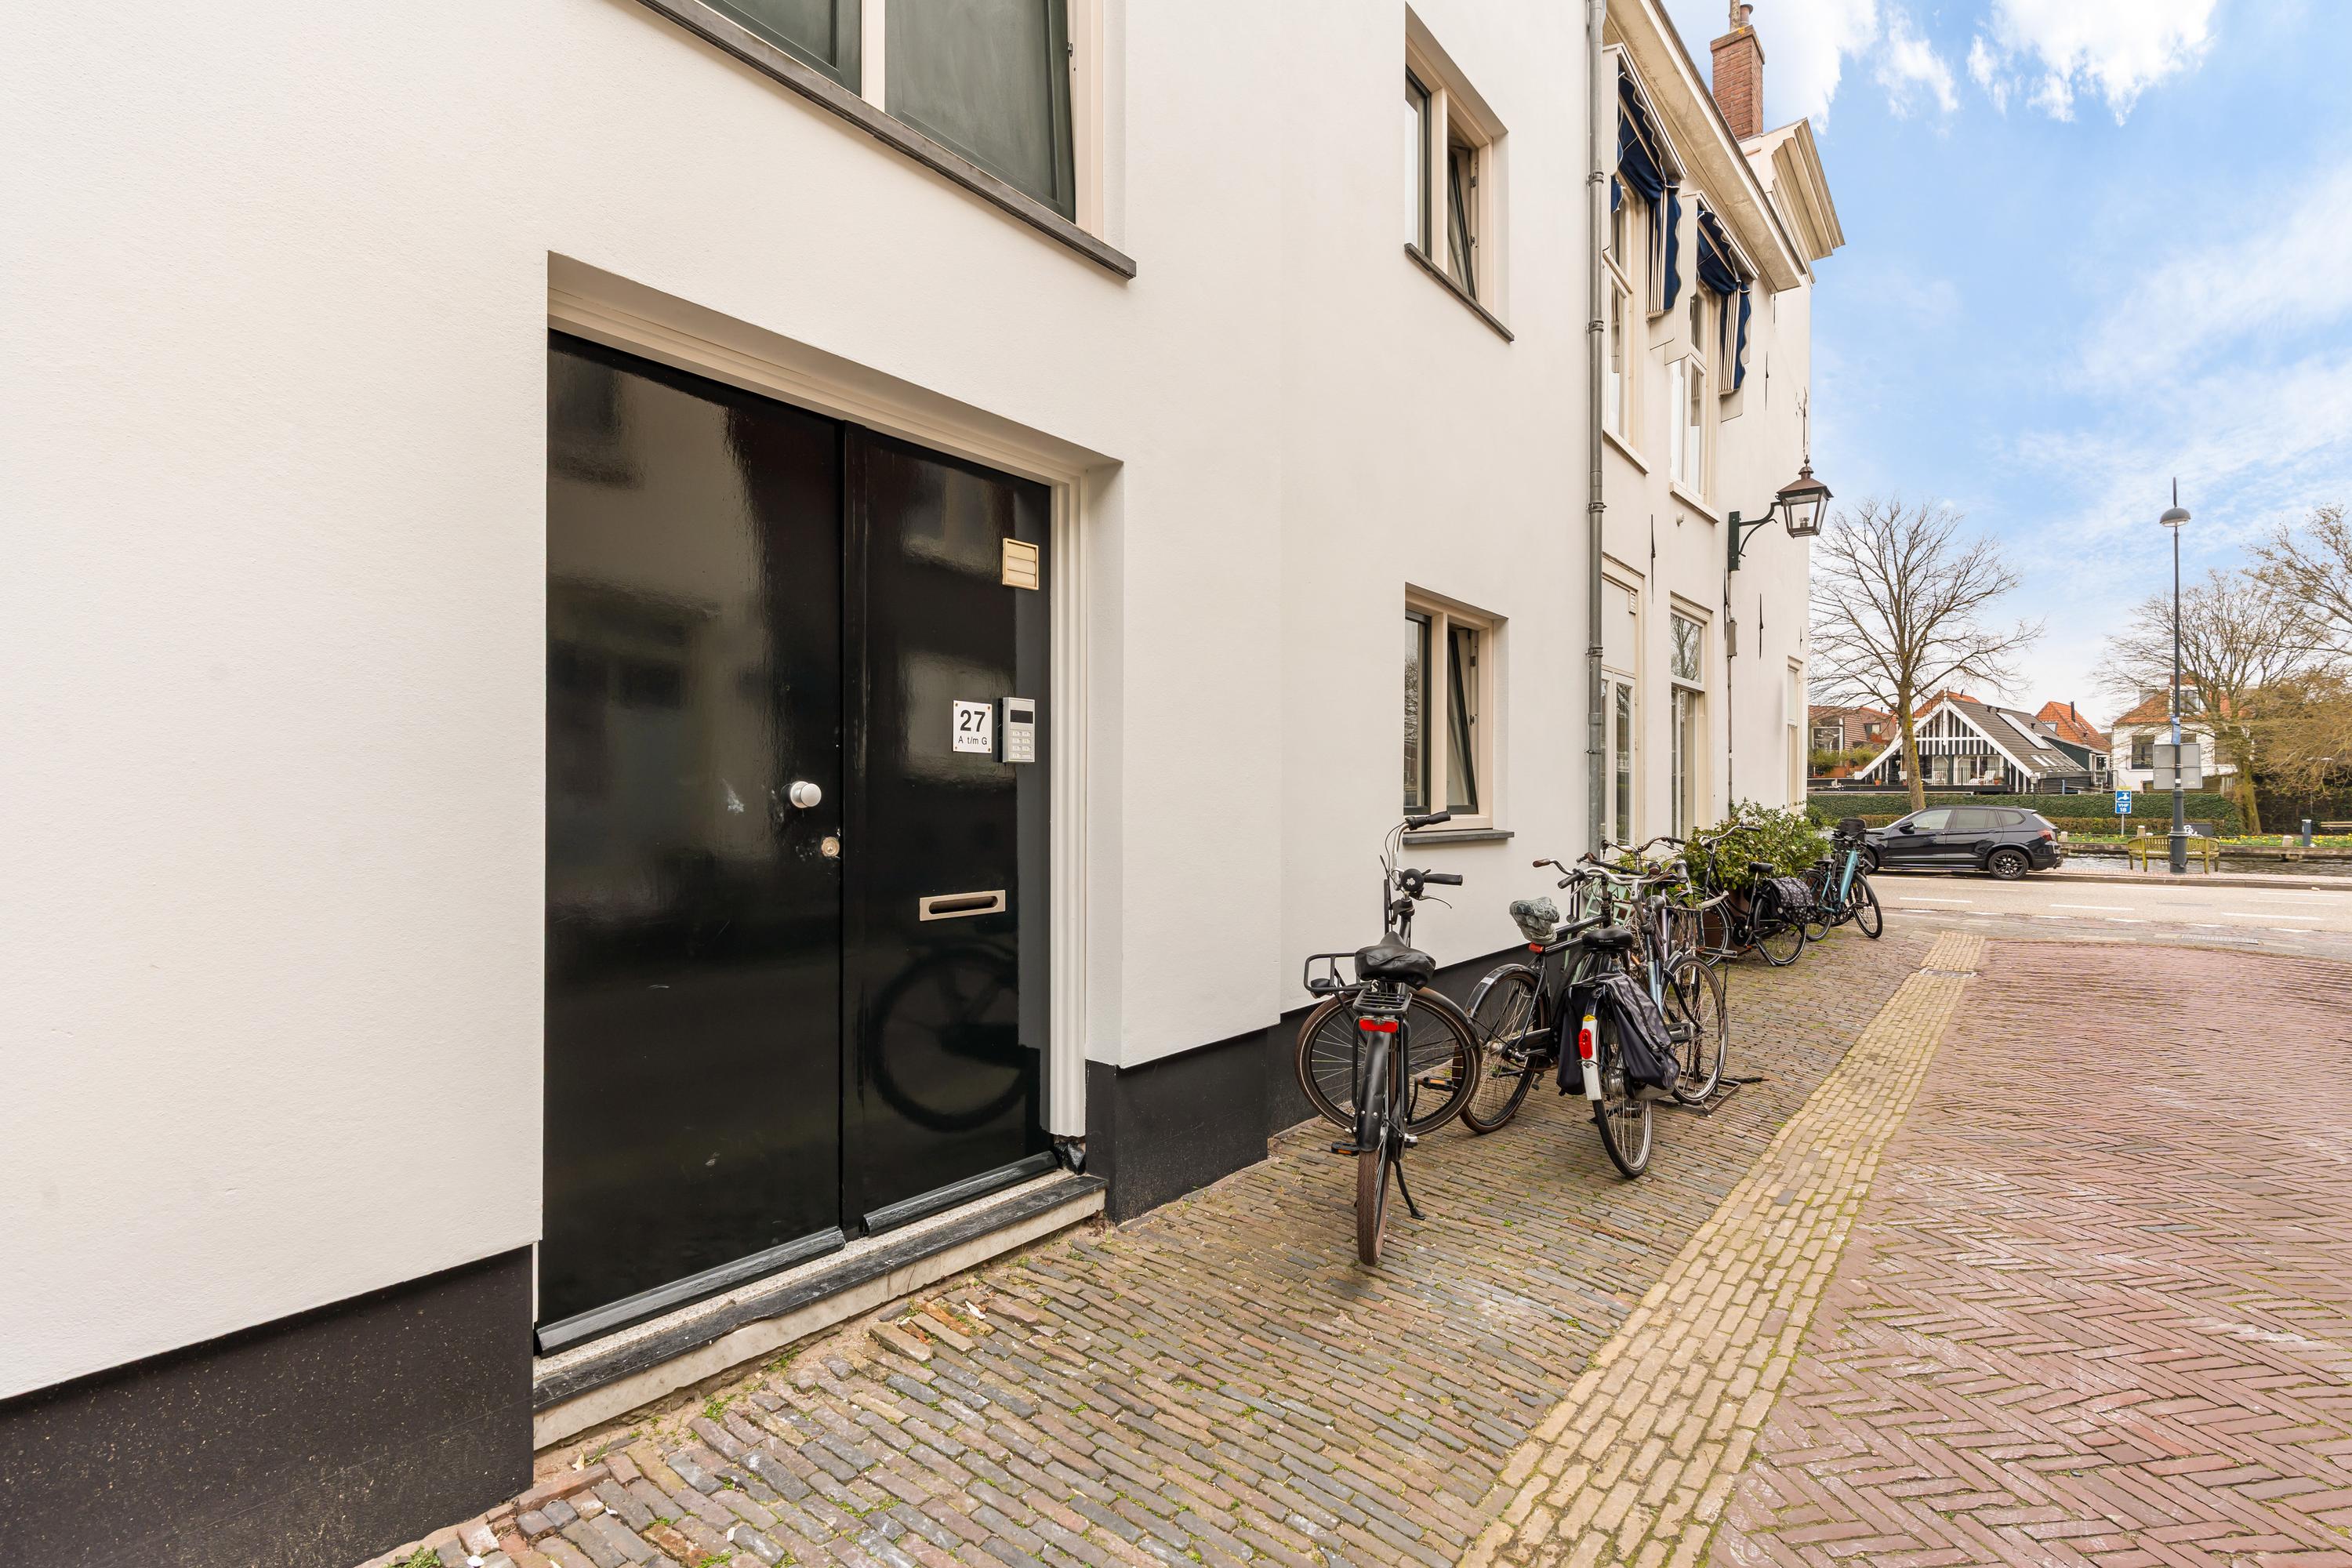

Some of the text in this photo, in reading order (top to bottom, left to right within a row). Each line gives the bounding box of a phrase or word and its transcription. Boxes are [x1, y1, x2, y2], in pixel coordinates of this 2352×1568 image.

[960, 710, 985, 732] 27
[958, 735, 964, 744] A
[967, 736, 978, 745] t/m
